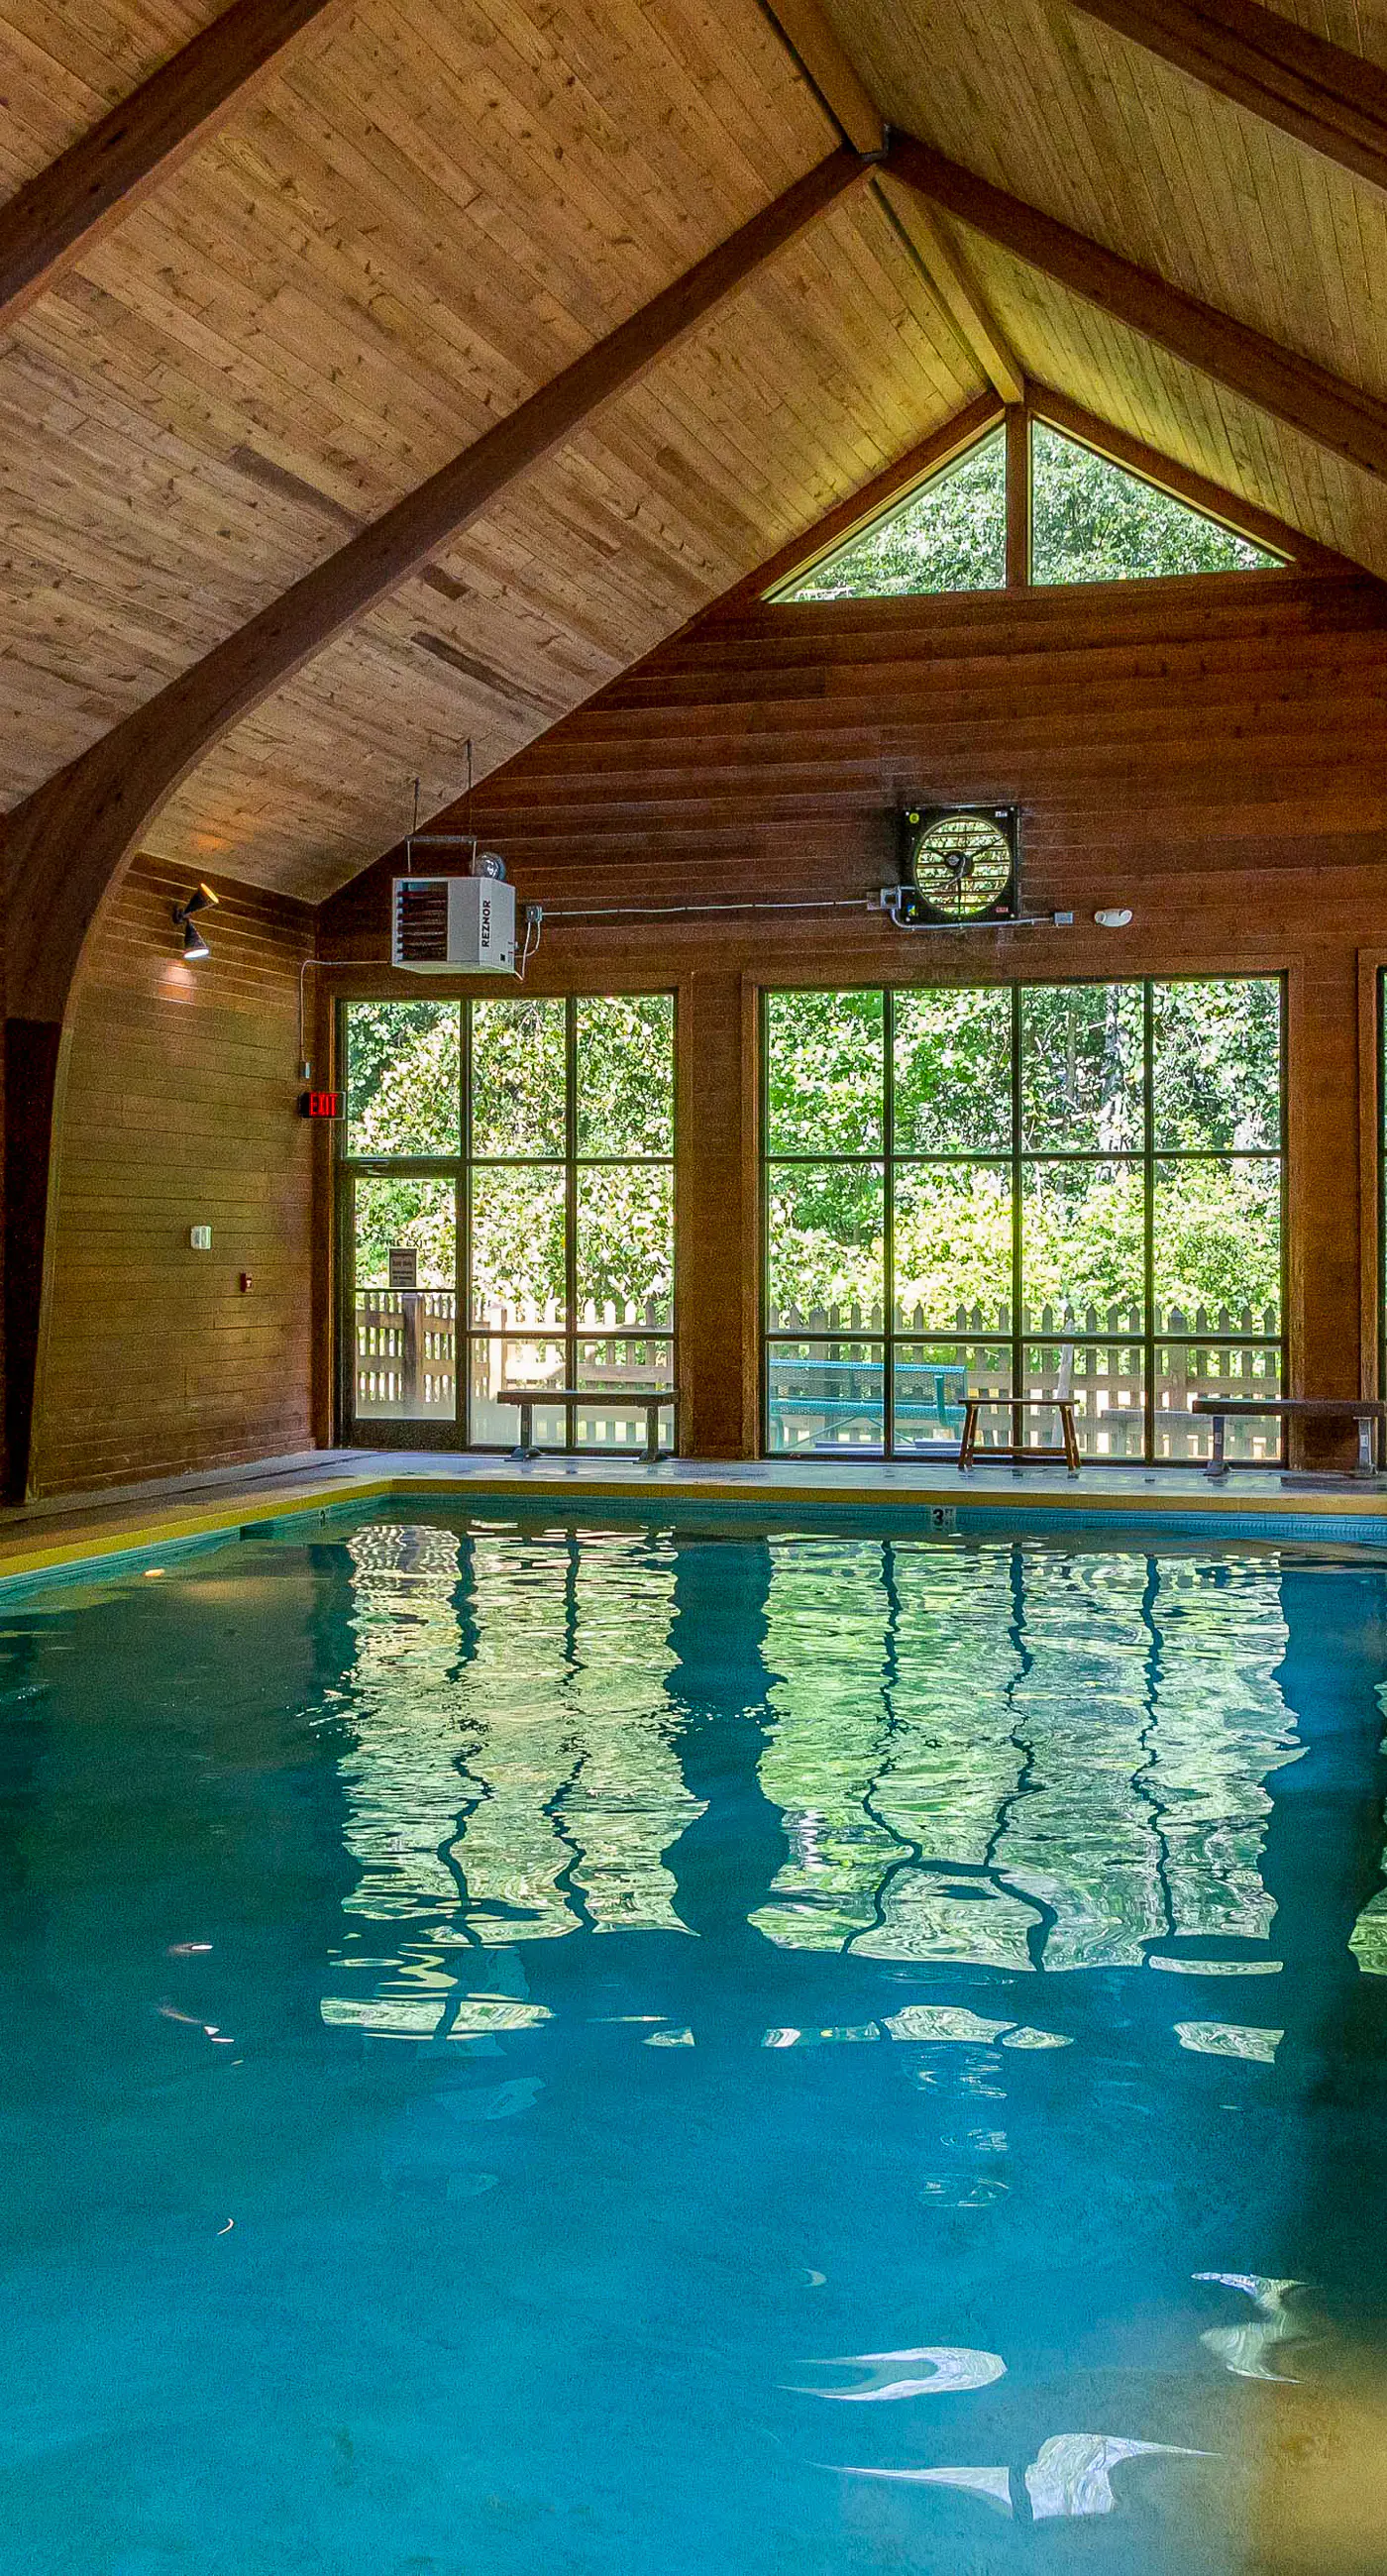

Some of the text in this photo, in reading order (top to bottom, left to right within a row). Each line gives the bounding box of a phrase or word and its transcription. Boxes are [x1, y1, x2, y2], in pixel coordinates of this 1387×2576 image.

[481, 900, 491, 947] REZNOR
[309, 1092, 339, 1117] EXIT
[406, 1238, 430, 1248] EXIT
[932, 1508, 944, 1527] 3
